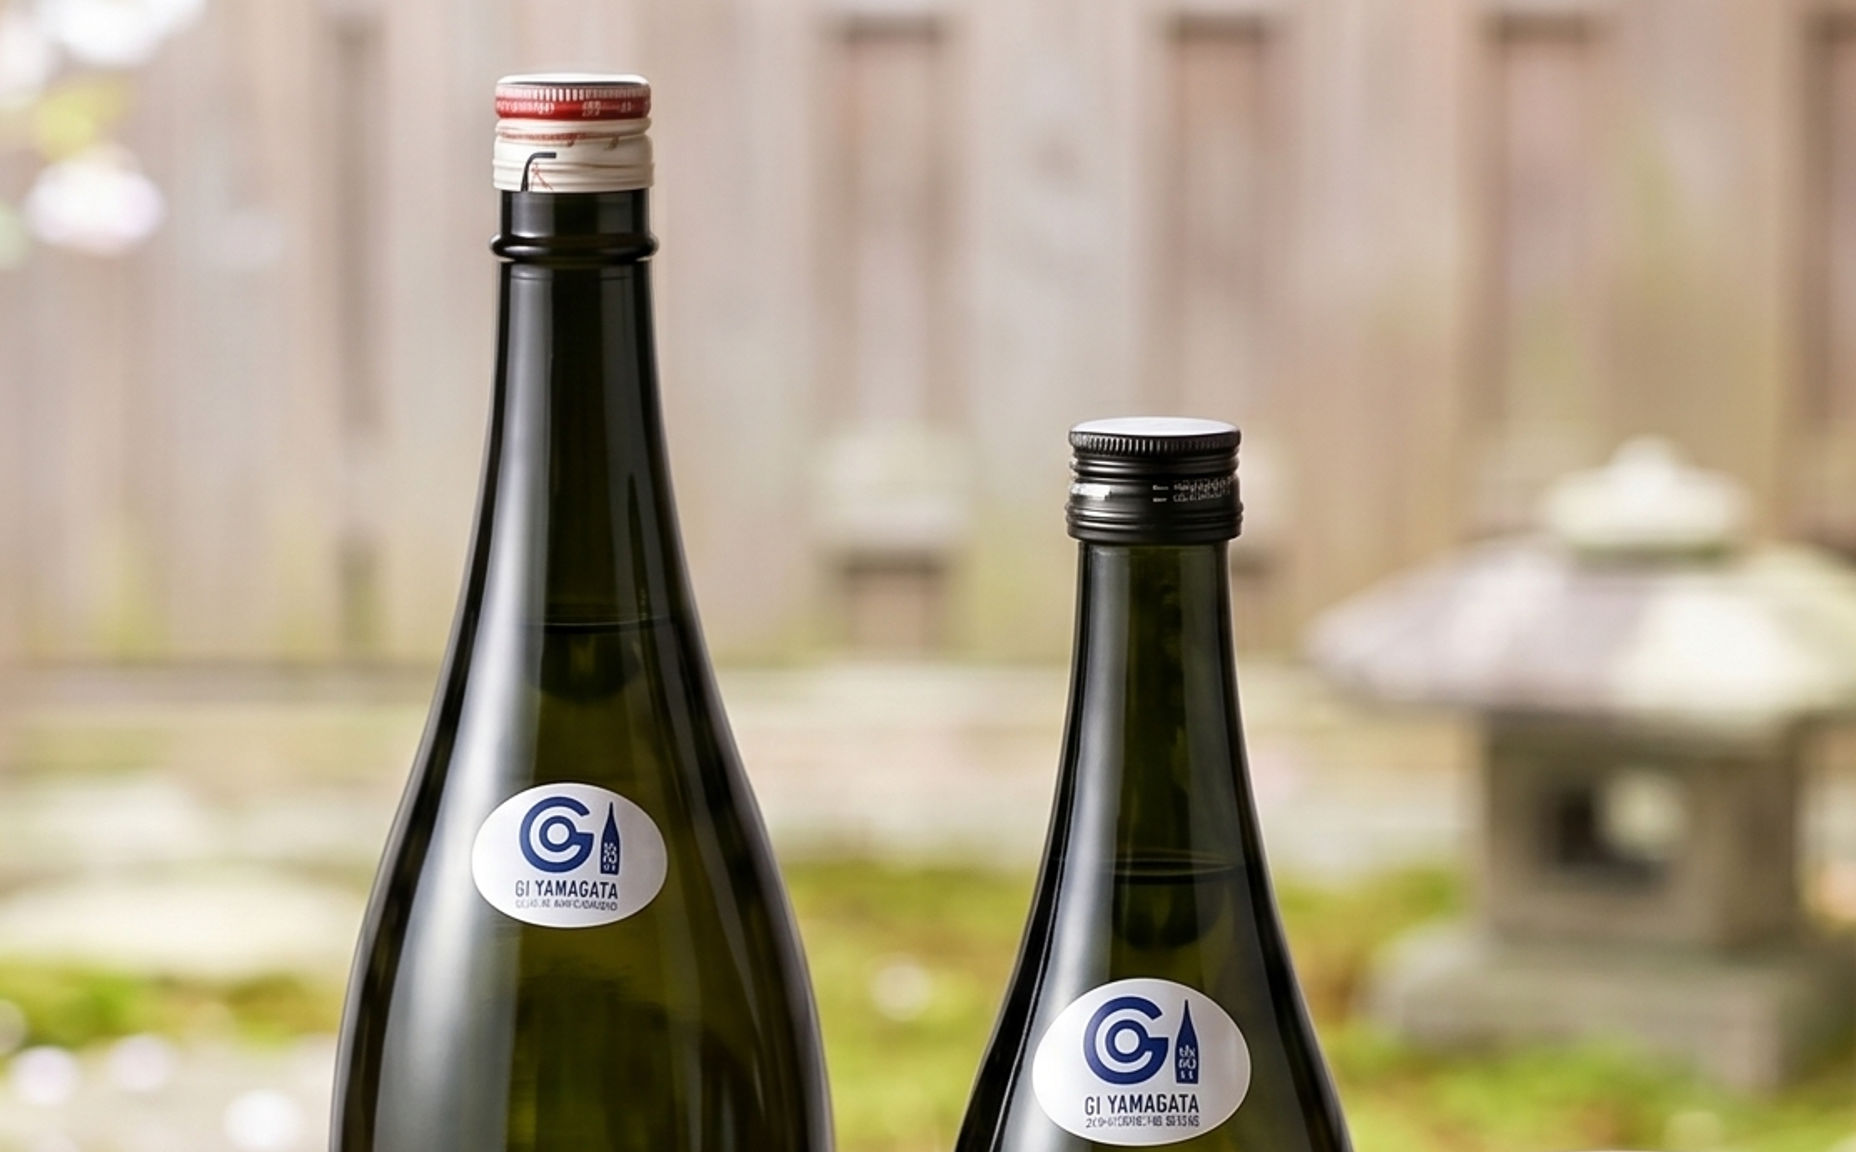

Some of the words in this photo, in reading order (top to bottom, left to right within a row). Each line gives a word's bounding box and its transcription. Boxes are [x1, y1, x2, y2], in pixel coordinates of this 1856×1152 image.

[515, 880, 531, 898] GI
[535, 880, 619, 899] YAMAGATA
[1084, 1096, 1101, 1116] GI
[1107, 1093, 1200, 1114] YAMAGATA
